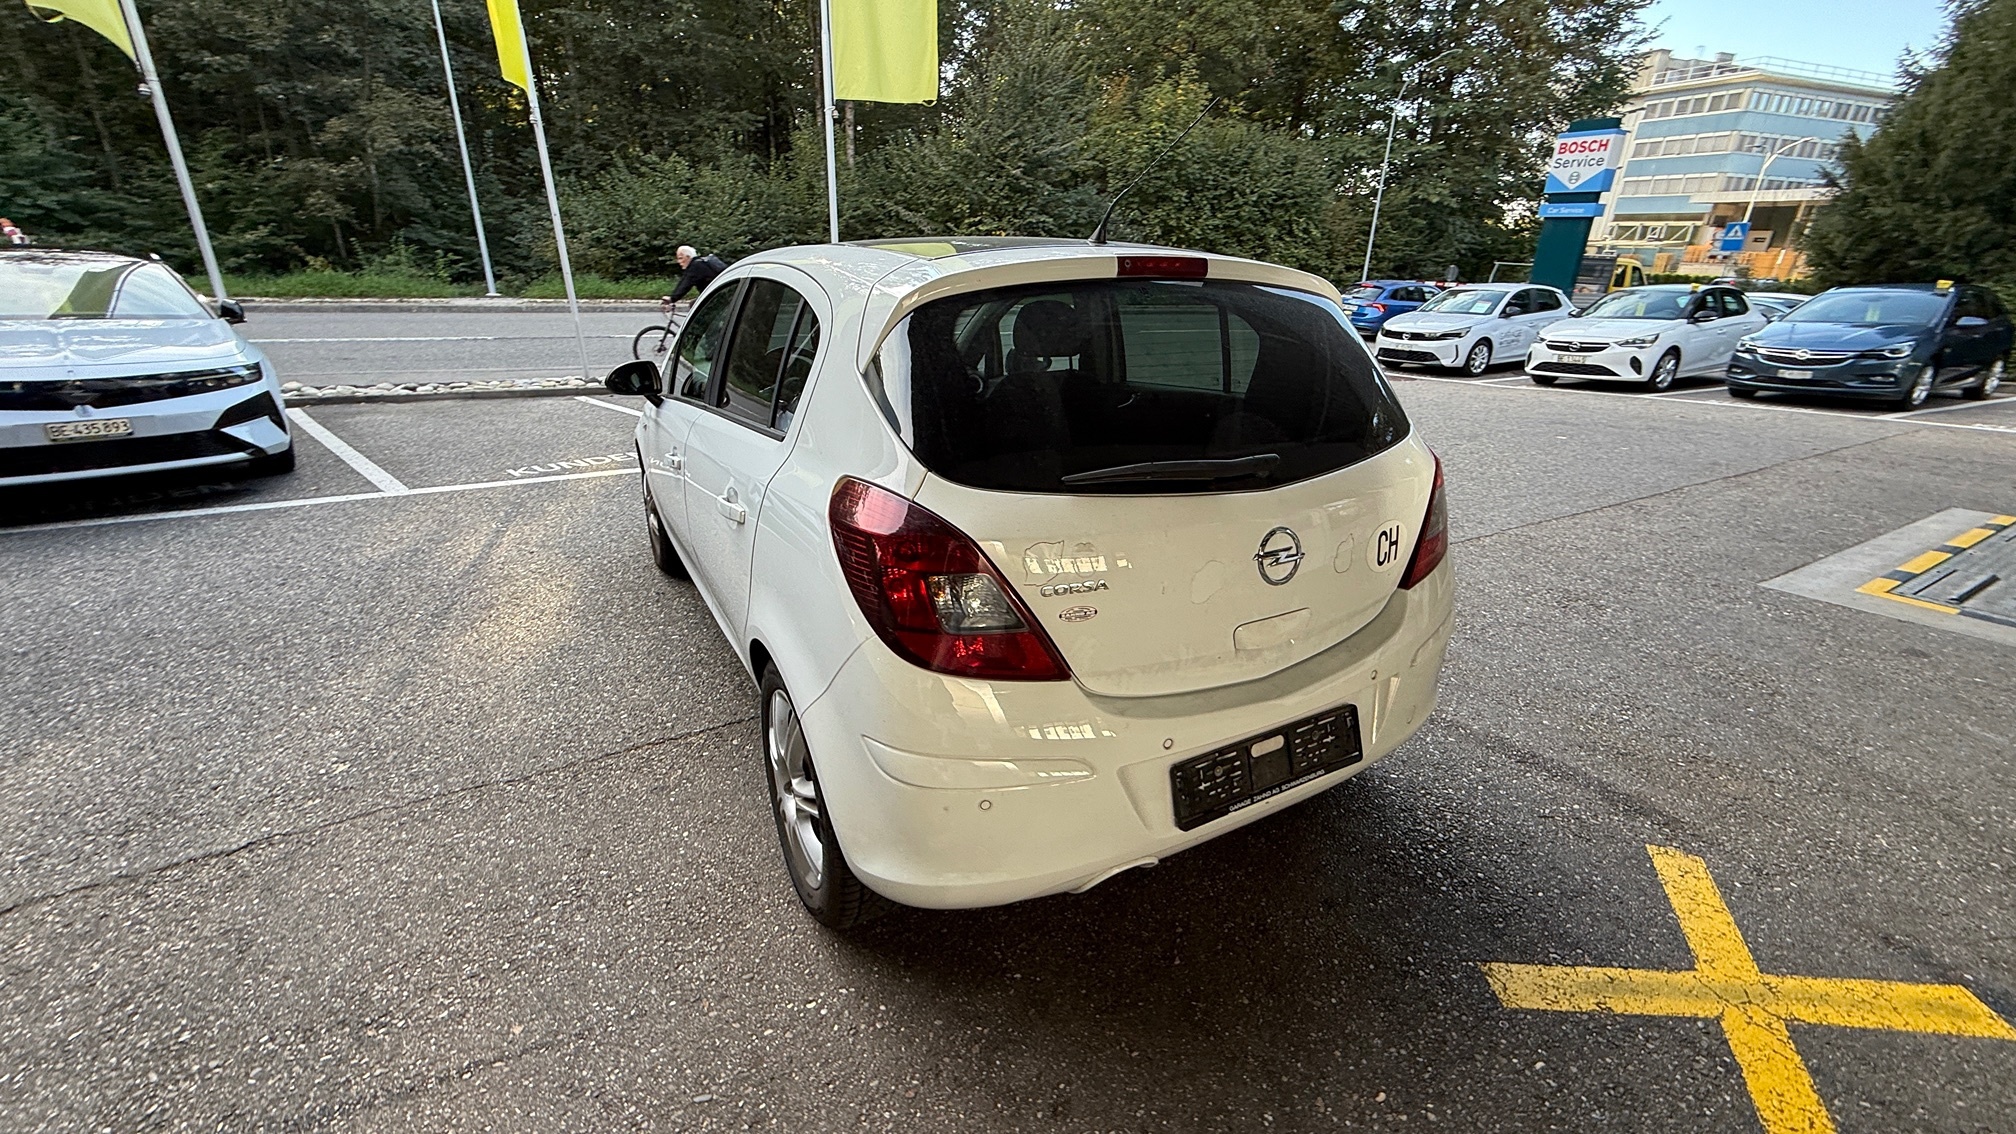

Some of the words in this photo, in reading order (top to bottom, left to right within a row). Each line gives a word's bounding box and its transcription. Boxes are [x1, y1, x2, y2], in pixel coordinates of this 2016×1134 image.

[1557, 139, 1610, 155] BOSCH
[1553, 155, 1605, 169] Service
[1547, 206, 1559, 214] Car
[1559, 206, 1585, 214] Service
[1377, 525, 1399, 567] CH
[1040, 579, 1110, 598] CORSA
[1229, 798, 1252, 812] GARAGE
